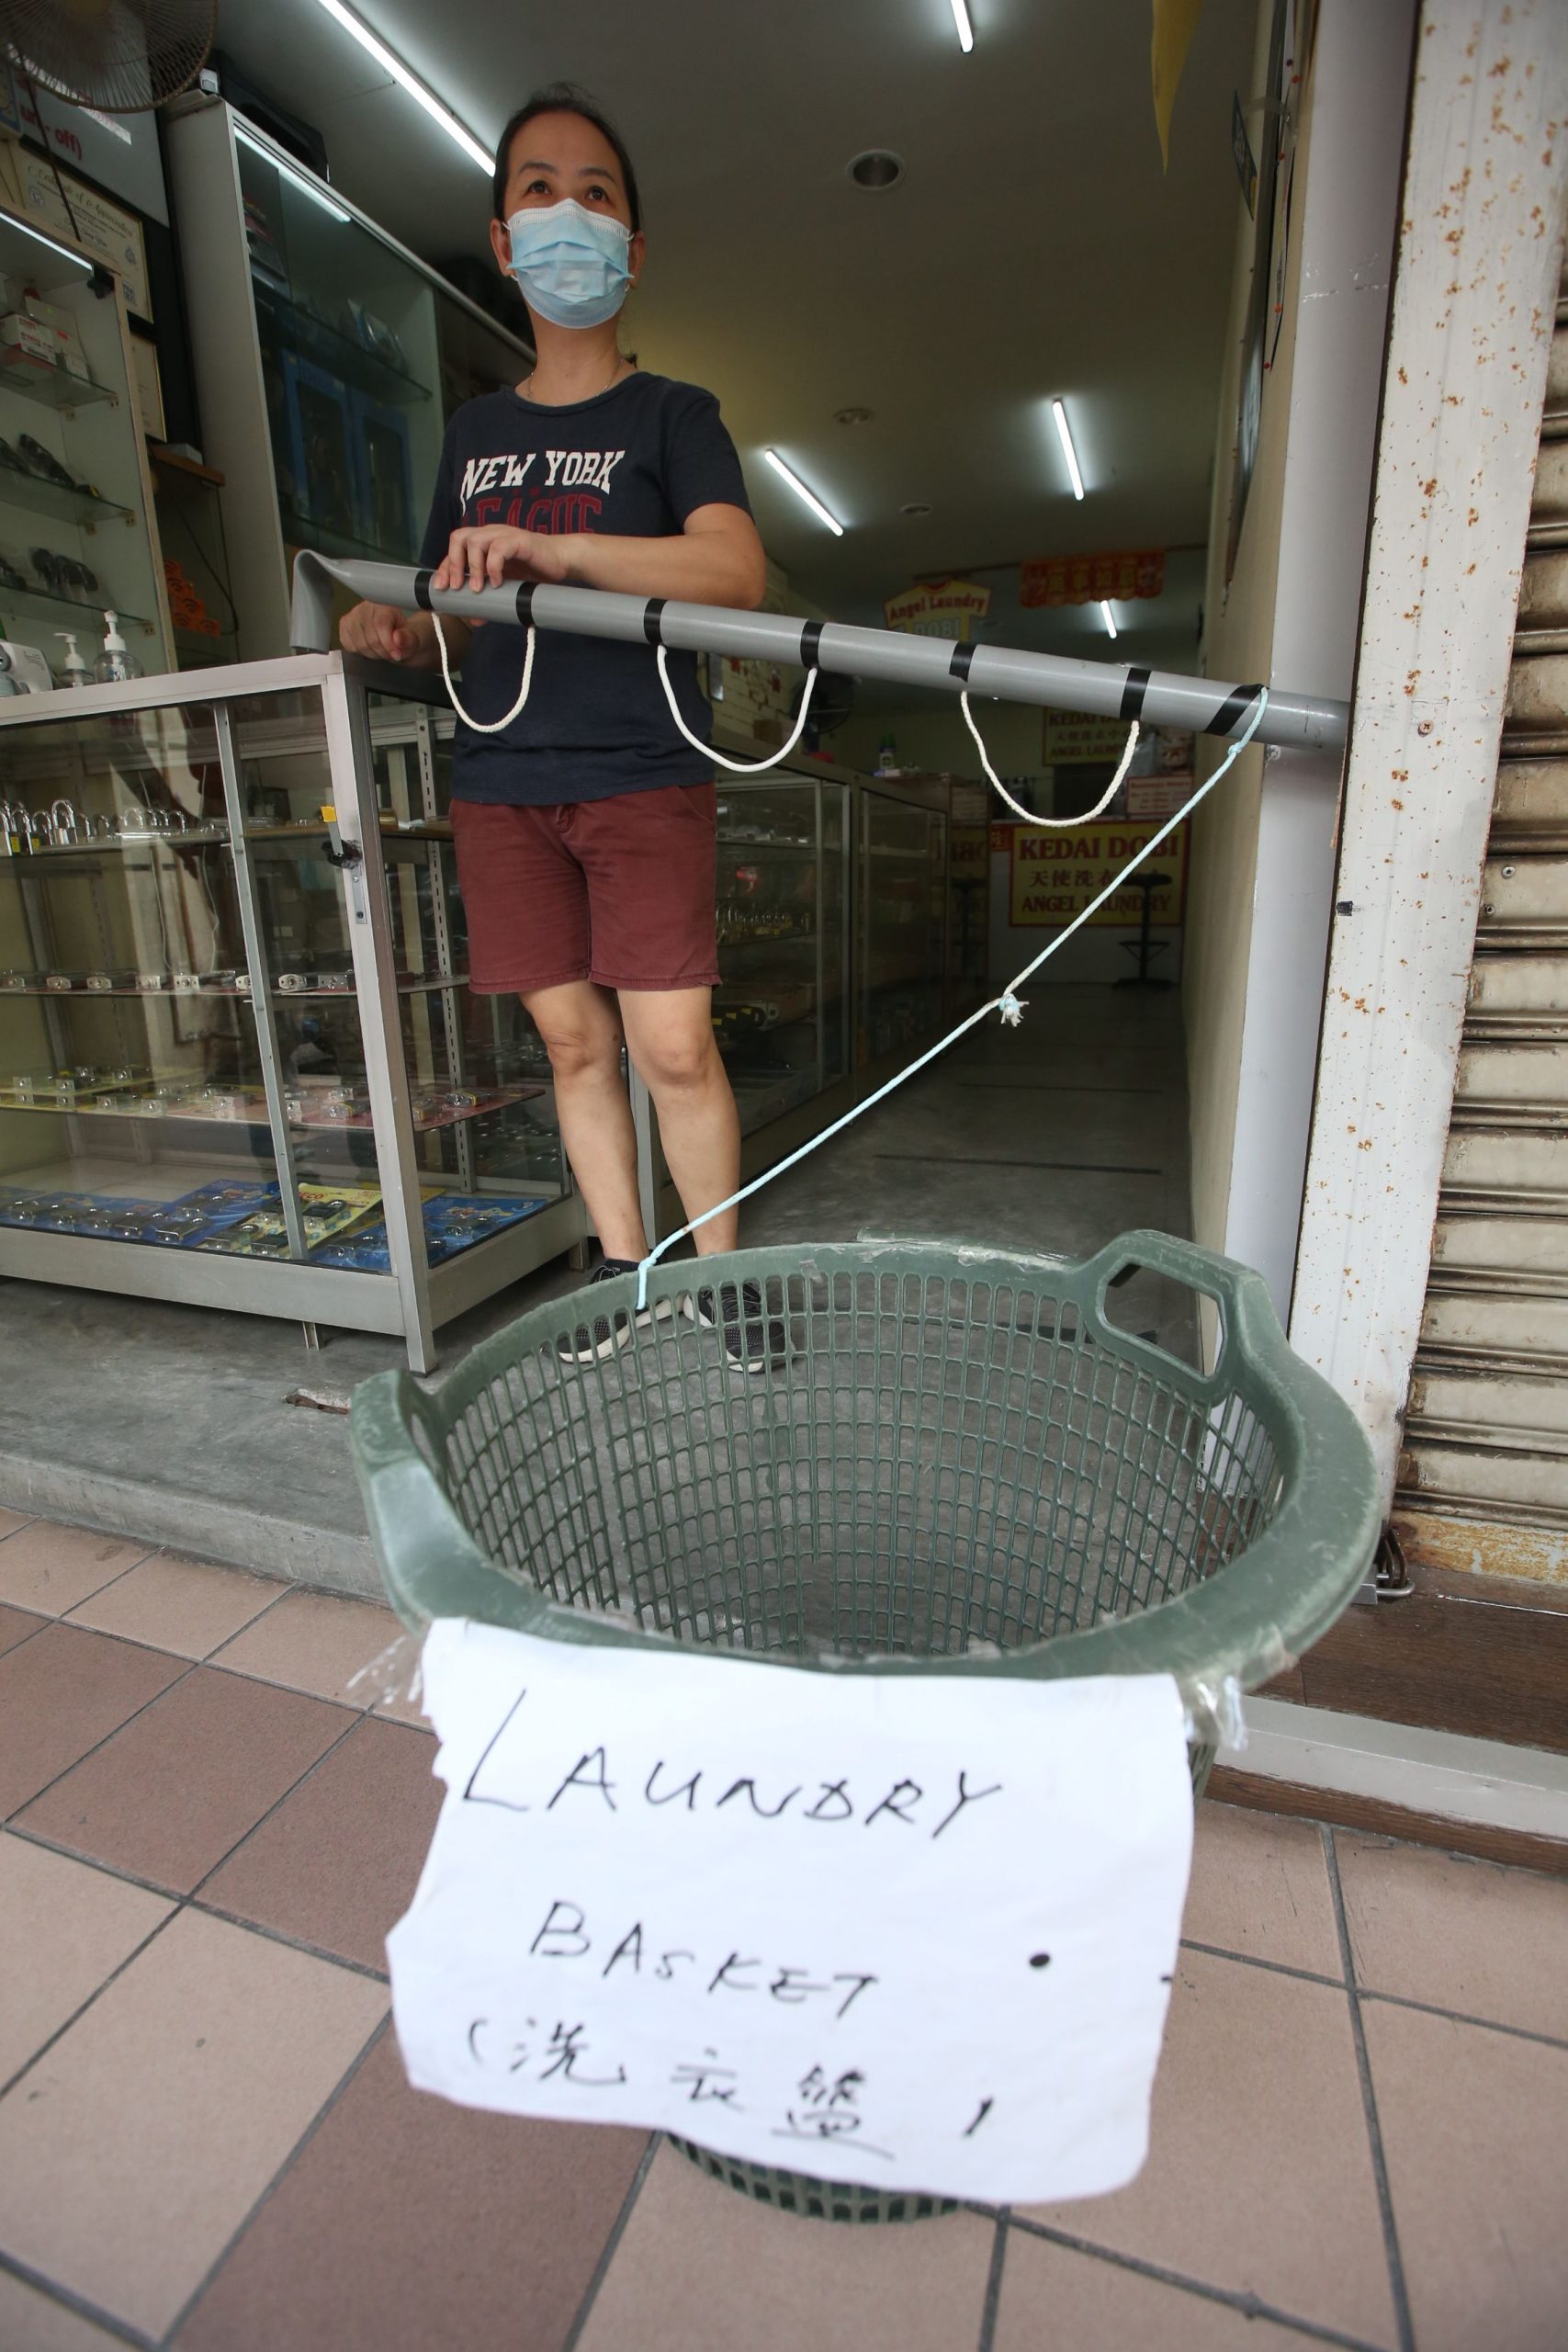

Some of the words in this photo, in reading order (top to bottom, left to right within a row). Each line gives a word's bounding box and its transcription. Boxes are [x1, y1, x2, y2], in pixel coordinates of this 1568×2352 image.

[460, 453, 536, 515] NEW
[545, 450, 626, 494] YORK
[463, 493, 602, 535] EAGUE
[890, 596, 926, 621] Angel
[930, 593, 986, 613] Laundry
[1020, 837, 1100, 861] KEDAI
[1109, 835, 1179, 858] DOBI
[1021, 895, 1078, 911] ANGEL
[462, 1688, 1002, 1839] LAUNDRY
[528, 1900, 880, 2018] BASKET
